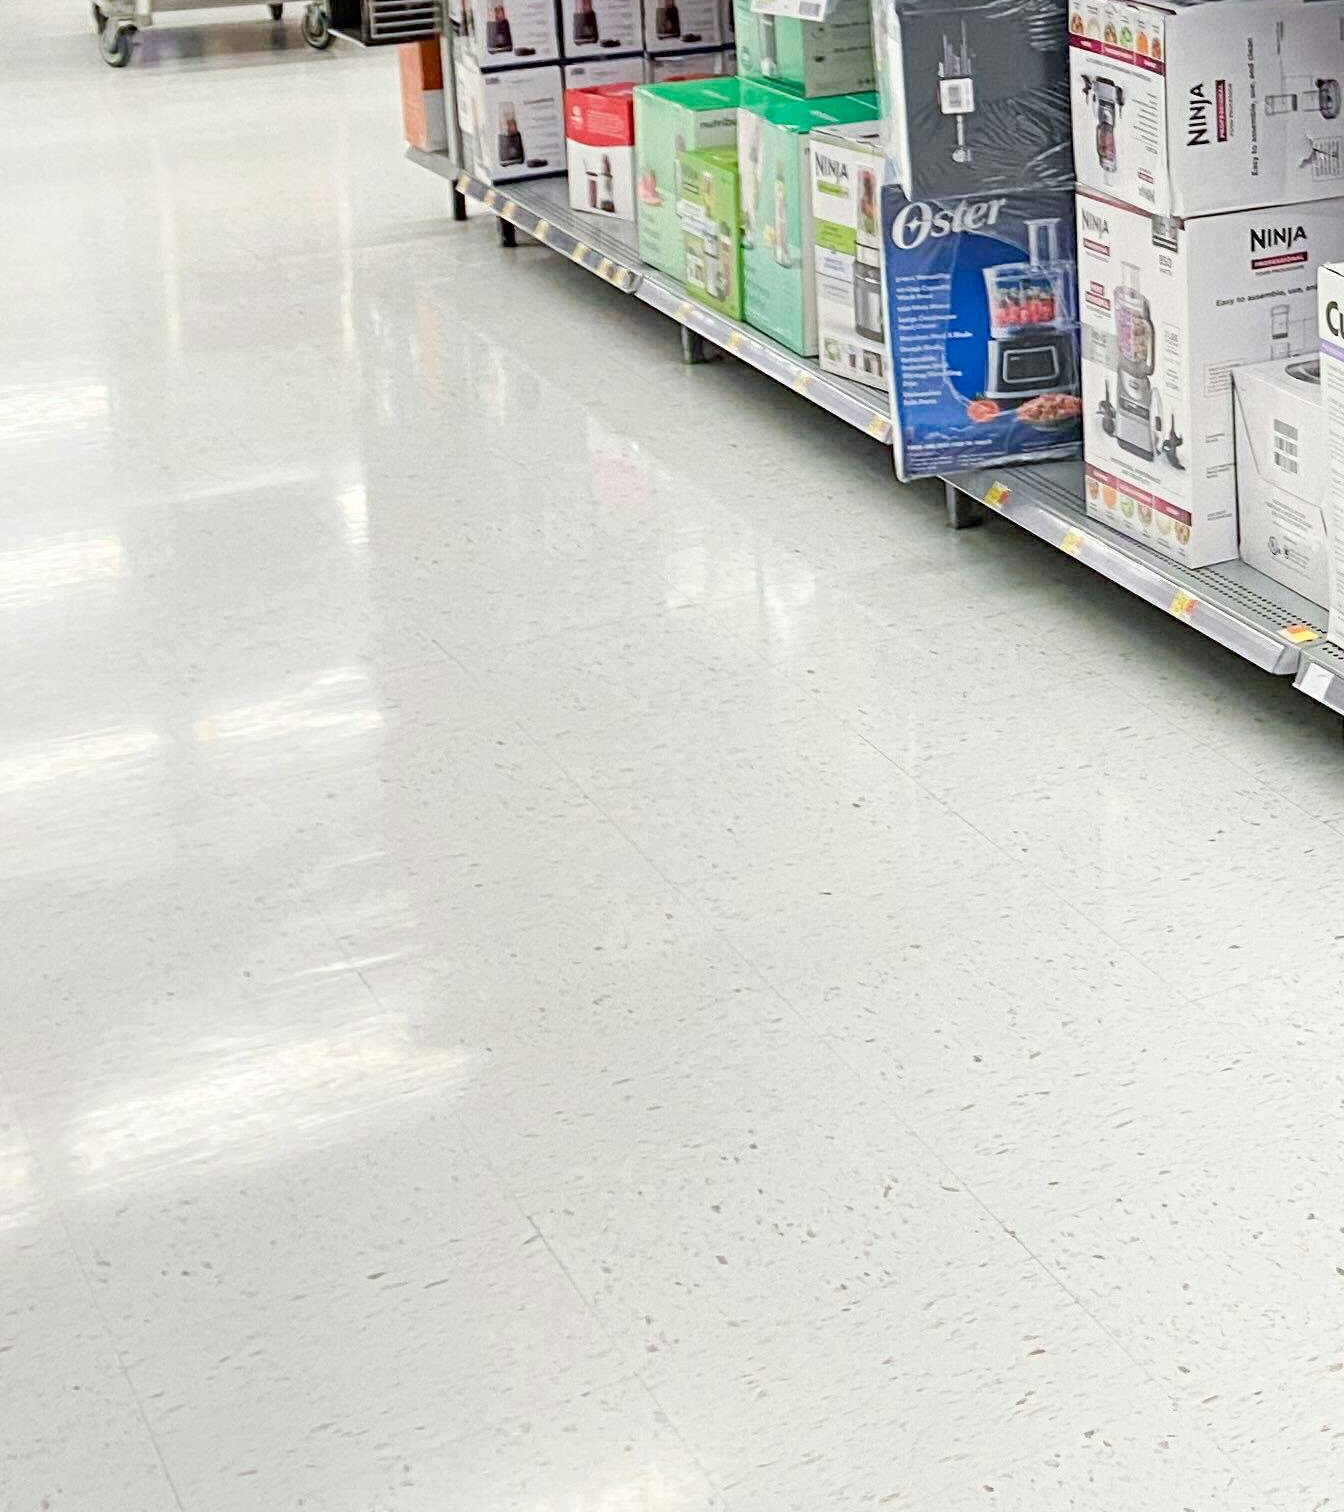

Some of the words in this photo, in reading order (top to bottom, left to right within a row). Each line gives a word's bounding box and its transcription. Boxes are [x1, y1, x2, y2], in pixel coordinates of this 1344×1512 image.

[1187, 83, 1212, 146] NINJA
[814, 153, 849, 182] NINJA
[891, 196, 1007, 251] Oster
[1081, 207, 1110, 235] NINJA
[1250, 226, 1307, 252] NINJA
[1216, 298, 1235, 307] Easy
